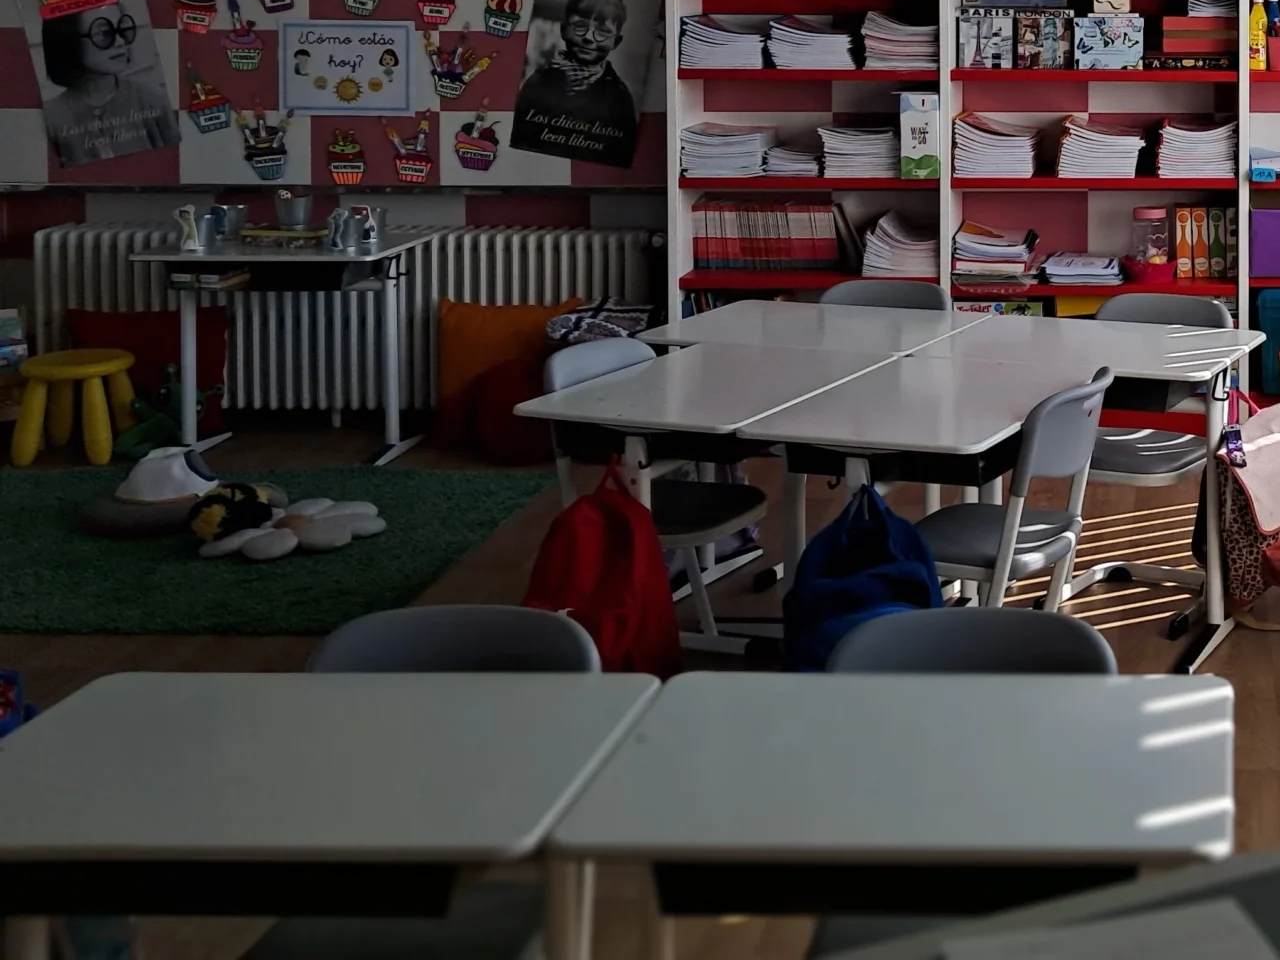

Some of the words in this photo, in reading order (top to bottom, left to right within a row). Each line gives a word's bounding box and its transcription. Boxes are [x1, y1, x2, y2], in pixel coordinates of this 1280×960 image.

[960, 8, 1011, 17] PARIS
[1016, 10, 1071, 18] LONDON
[298, 31, 352, 45] ¿Cómo
[358, 33, 395, 45] estás
[328, 54, 364, 74] hoy?
[525, 108, 549, 125] Los
[551, 115, 591, 132] chicos
[592, 121, 624, 139] listos
[540, 128, 566, 144] leen
[568, 133, 605, 151] libros
